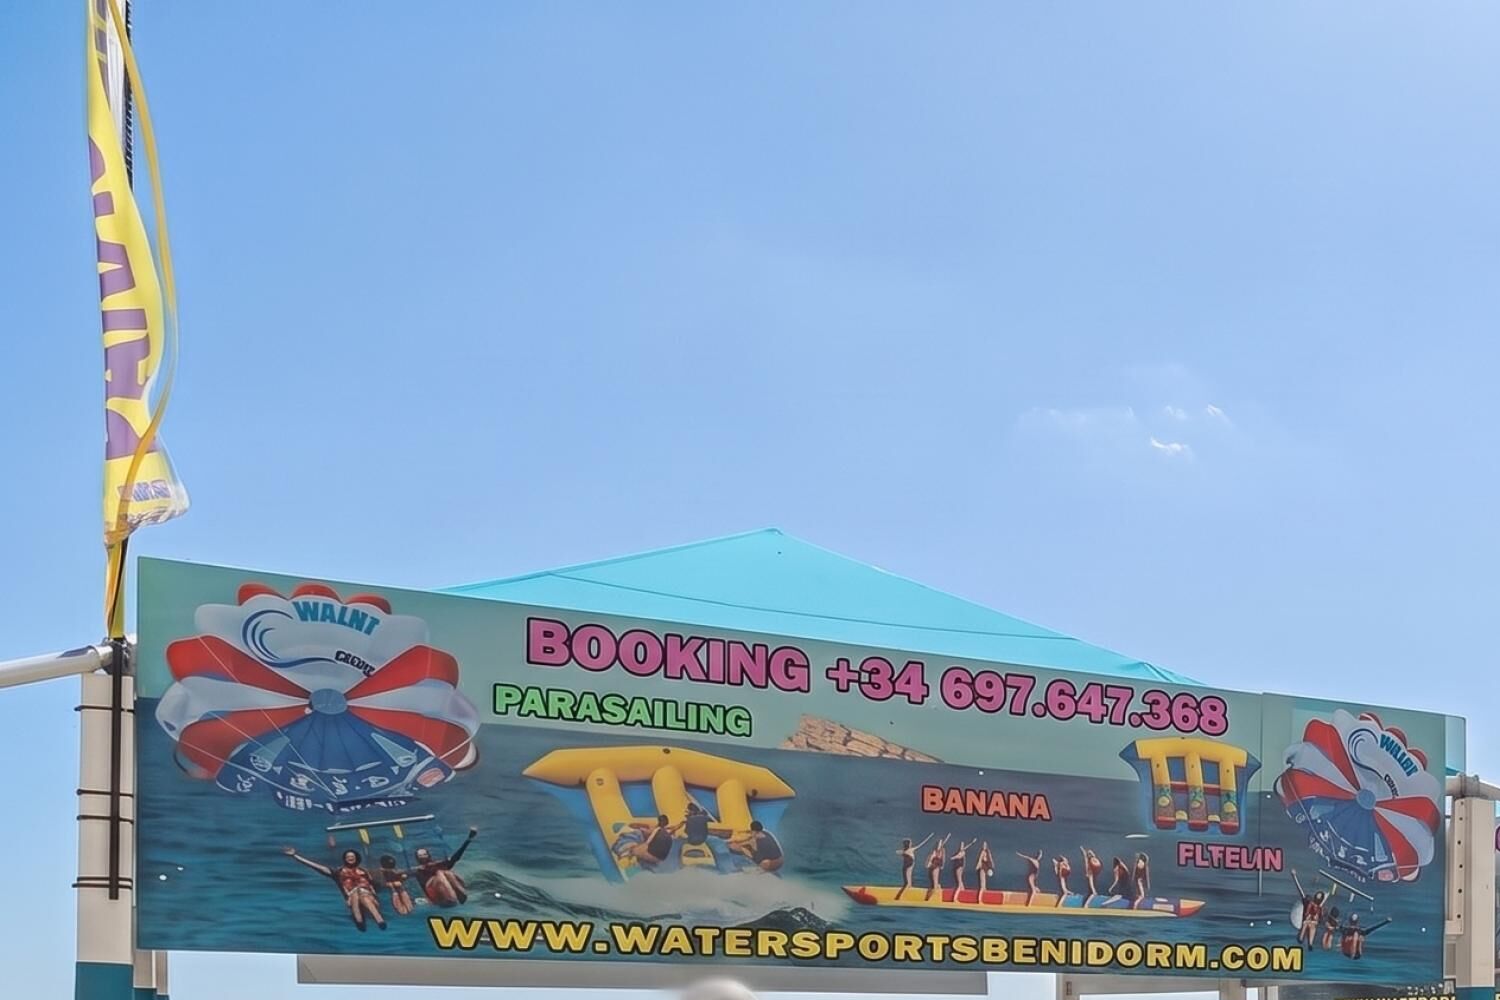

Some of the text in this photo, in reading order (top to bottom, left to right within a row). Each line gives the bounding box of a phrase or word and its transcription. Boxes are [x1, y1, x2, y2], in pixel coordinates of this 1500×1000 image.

[526, 616, 1228, 737] BOOKING +34 697.647.368
[492, 682, 753, 737] PARASAILING
[921, 784, 1052, 822] BANANA
[430, 915, 1304, 974] WWW.WATERSPORTSBENIDORM.COM
